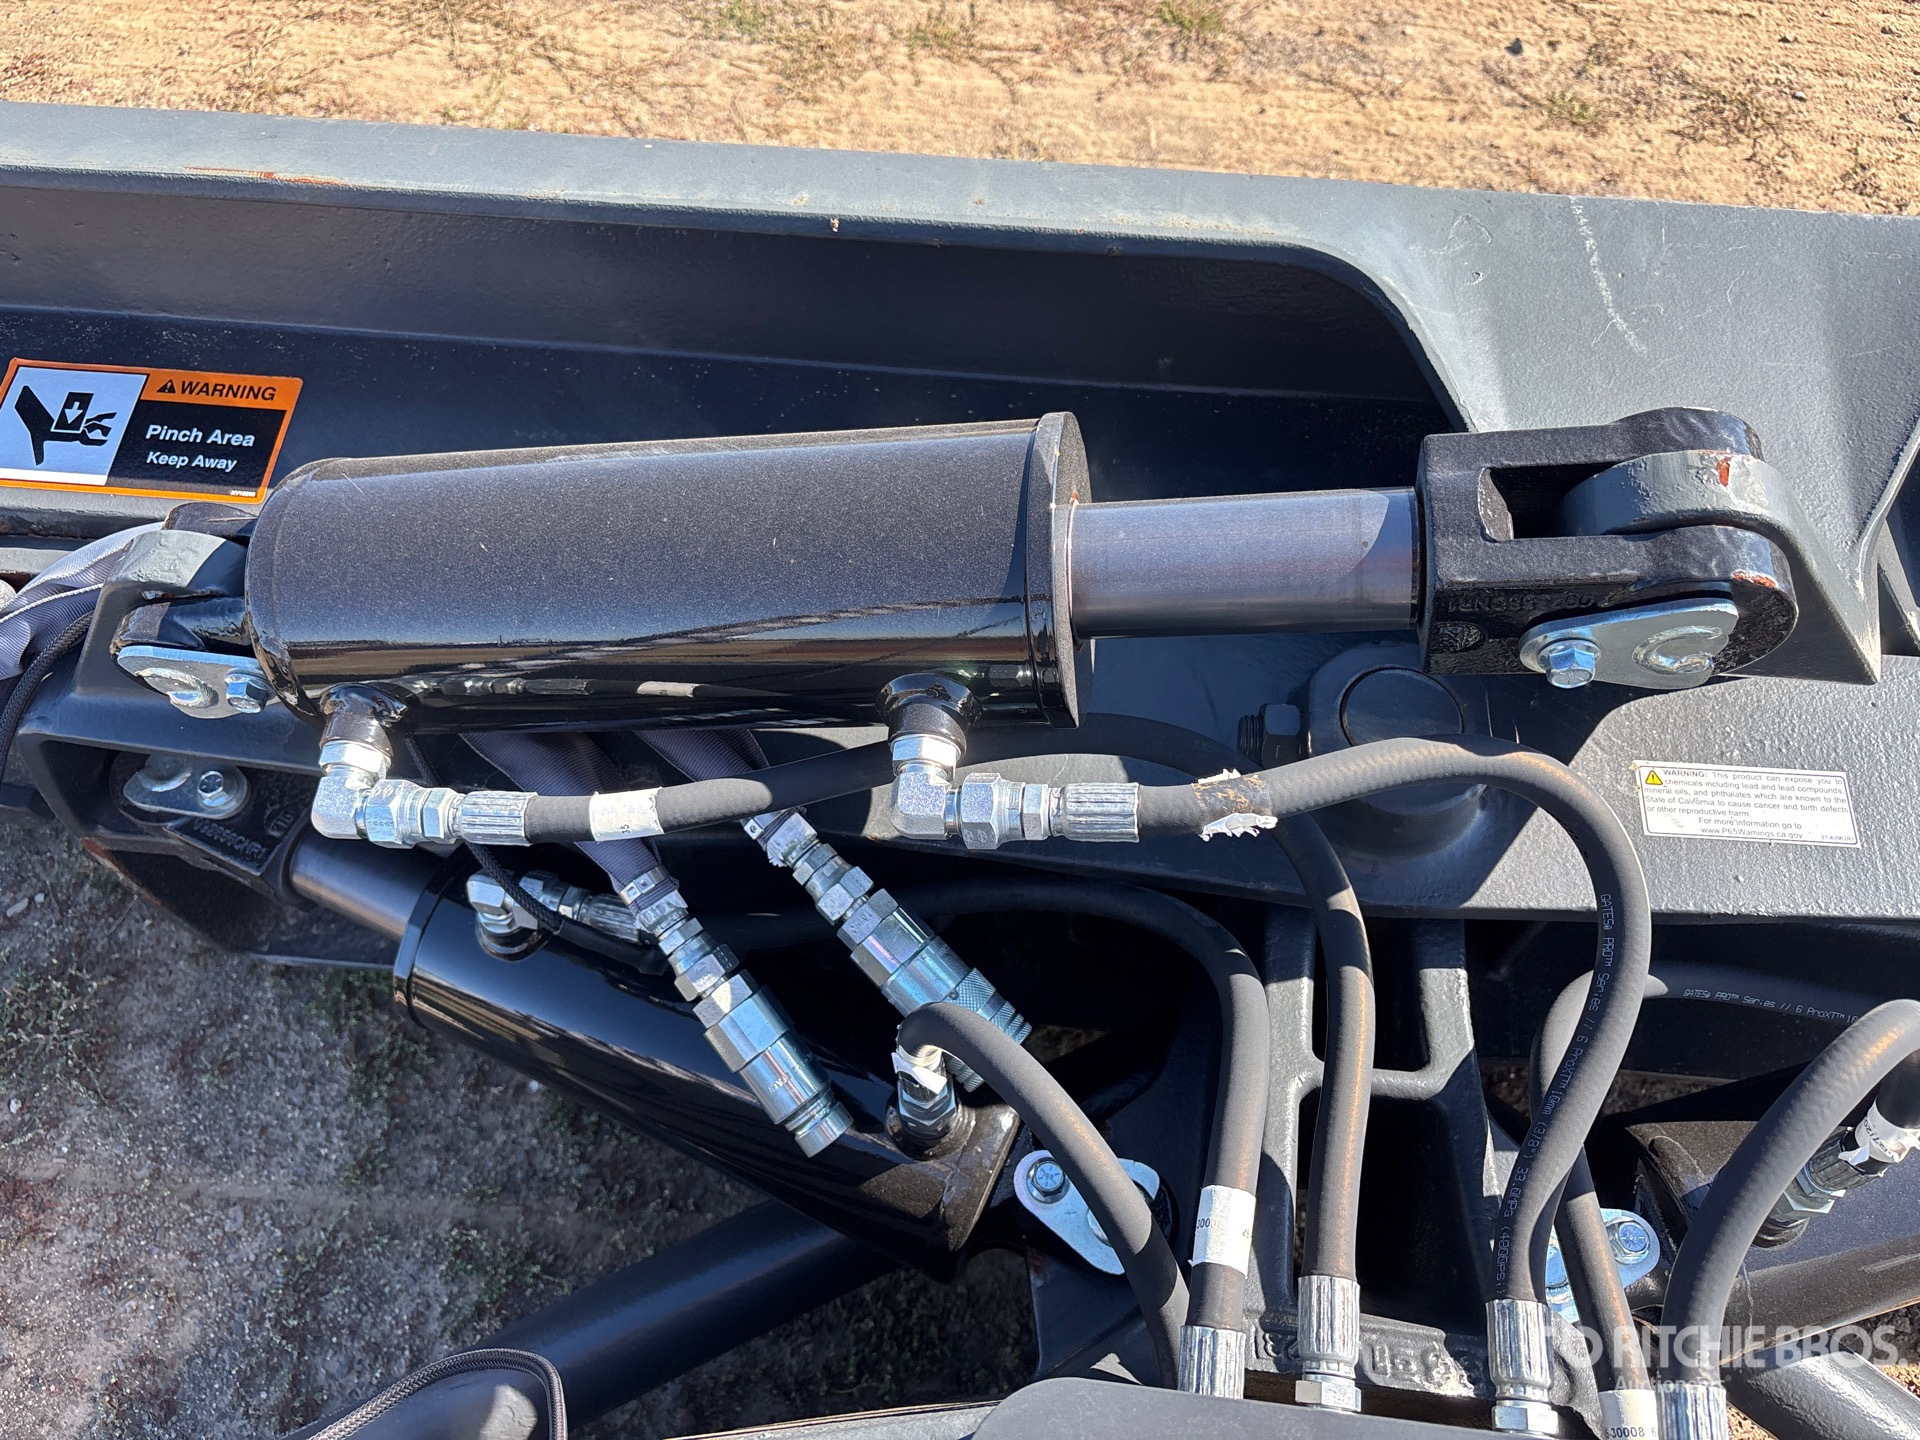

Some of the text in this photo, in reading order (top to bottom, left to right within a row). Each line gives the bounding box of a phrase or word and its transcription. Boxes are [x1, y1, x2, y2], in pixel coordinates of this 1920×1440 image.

[181, 381, 277, 401] WARNING
[145, 424, 255, 447] Pinch Area
[146, 451, 237, 472] Keep Away
[1663, 769, 1708, 778] WARNING:
[1712, 771, 1729, 779] This
[1733, 773, 1763, 782] product
[1785, 776, 1813, 785] expose
[1817, 778, 1831, 786] you
[1664, 778, 1703, 787] chemicals
[1706, 779, 1740, 790] including
[1741, 781, 1759, 790] lead
[1761, 783, 1776, 791] and
[1778, 784, 1795, 792] lead
[1644, 786, 1672, 794] mineral
[1693, 789, 1708, 797] and
[1711, 790, 1752, 799] phthalates
[1754, 792, 1777, 800] which
[1678, 797, 1715, 805] California
[1820, 804, 1849, 813] defects
[1679, 807, 1727, 816] reproductive
[1698, 816, 1712, 824] For
[1588, 972, 1610, 1012] Series
[1742, 995, 1777, 1008] Series
